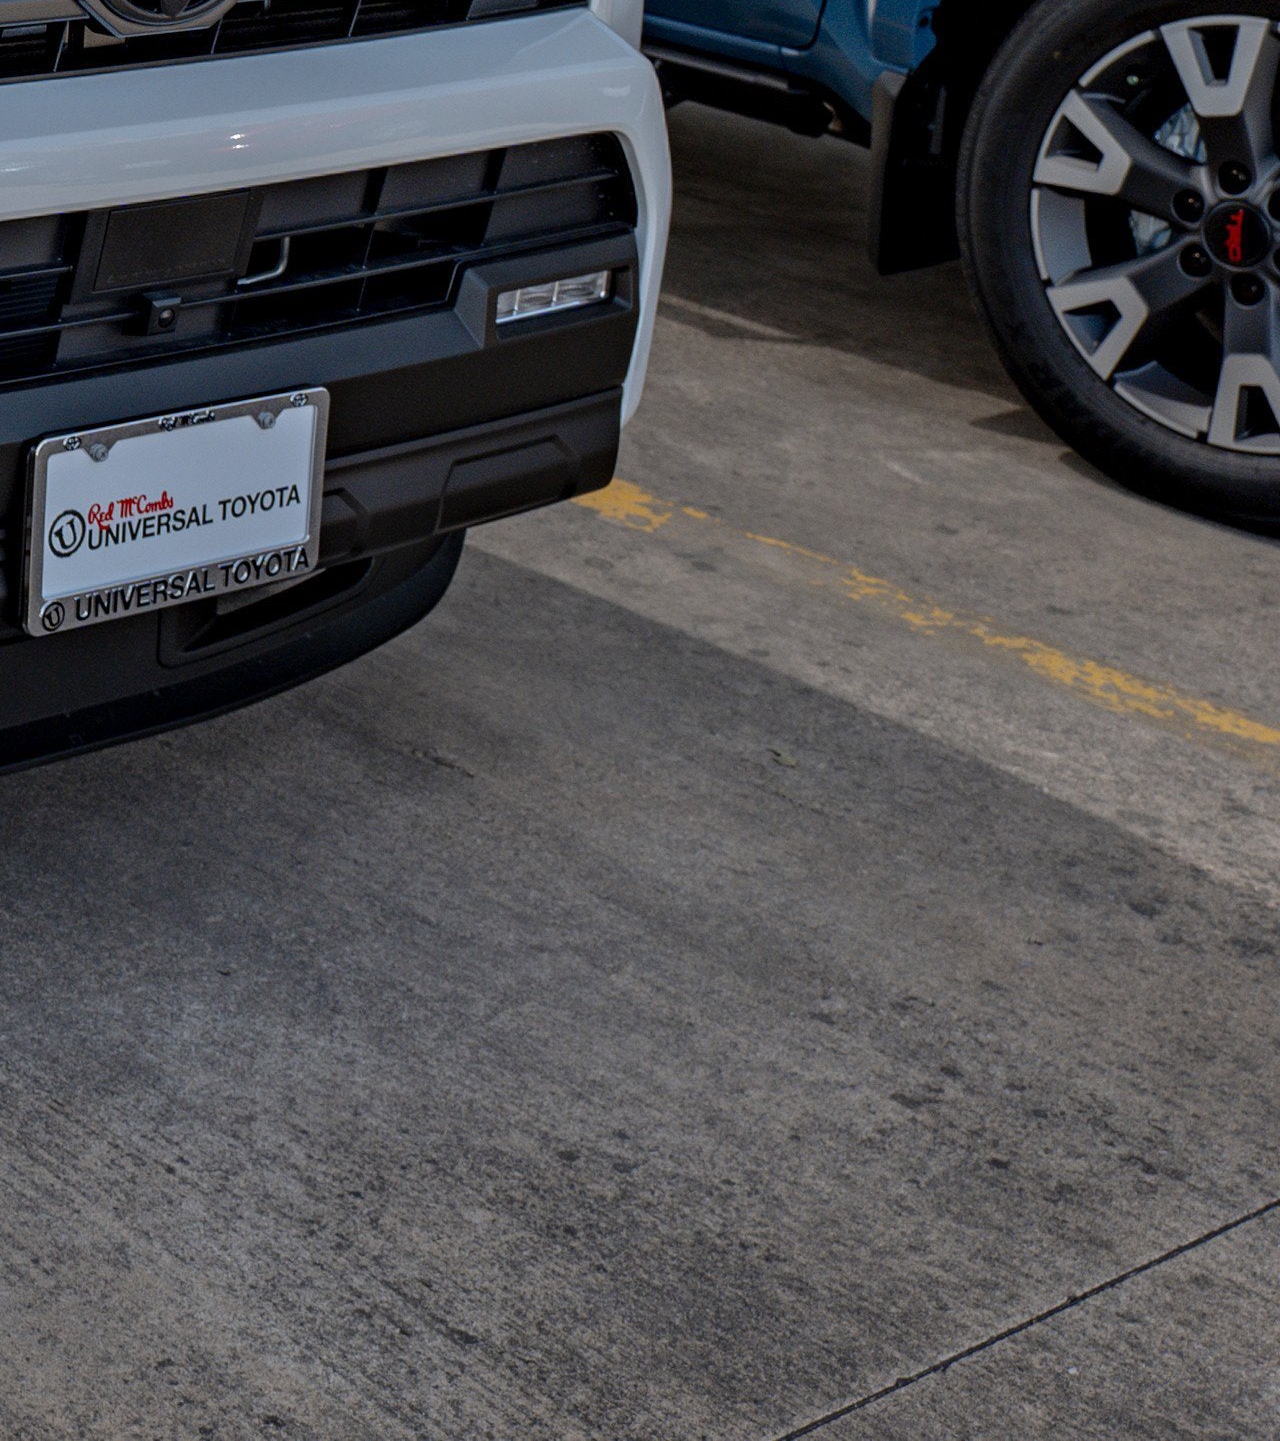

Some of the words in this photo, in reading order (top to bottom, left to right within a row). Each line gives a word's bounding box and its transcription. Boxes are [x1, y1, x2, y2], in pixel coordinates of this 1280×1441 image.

[88, 501, 114, 530] Red
[116, 491, 174, 518] McCombs
[88, 504, 213, 550] UNIVERSAL
[218, 484, 301, 521] TOYOTA
[73, 567, 216, 621] UNIVERSAL
[218, 546, 310, 587] TOYOTA
